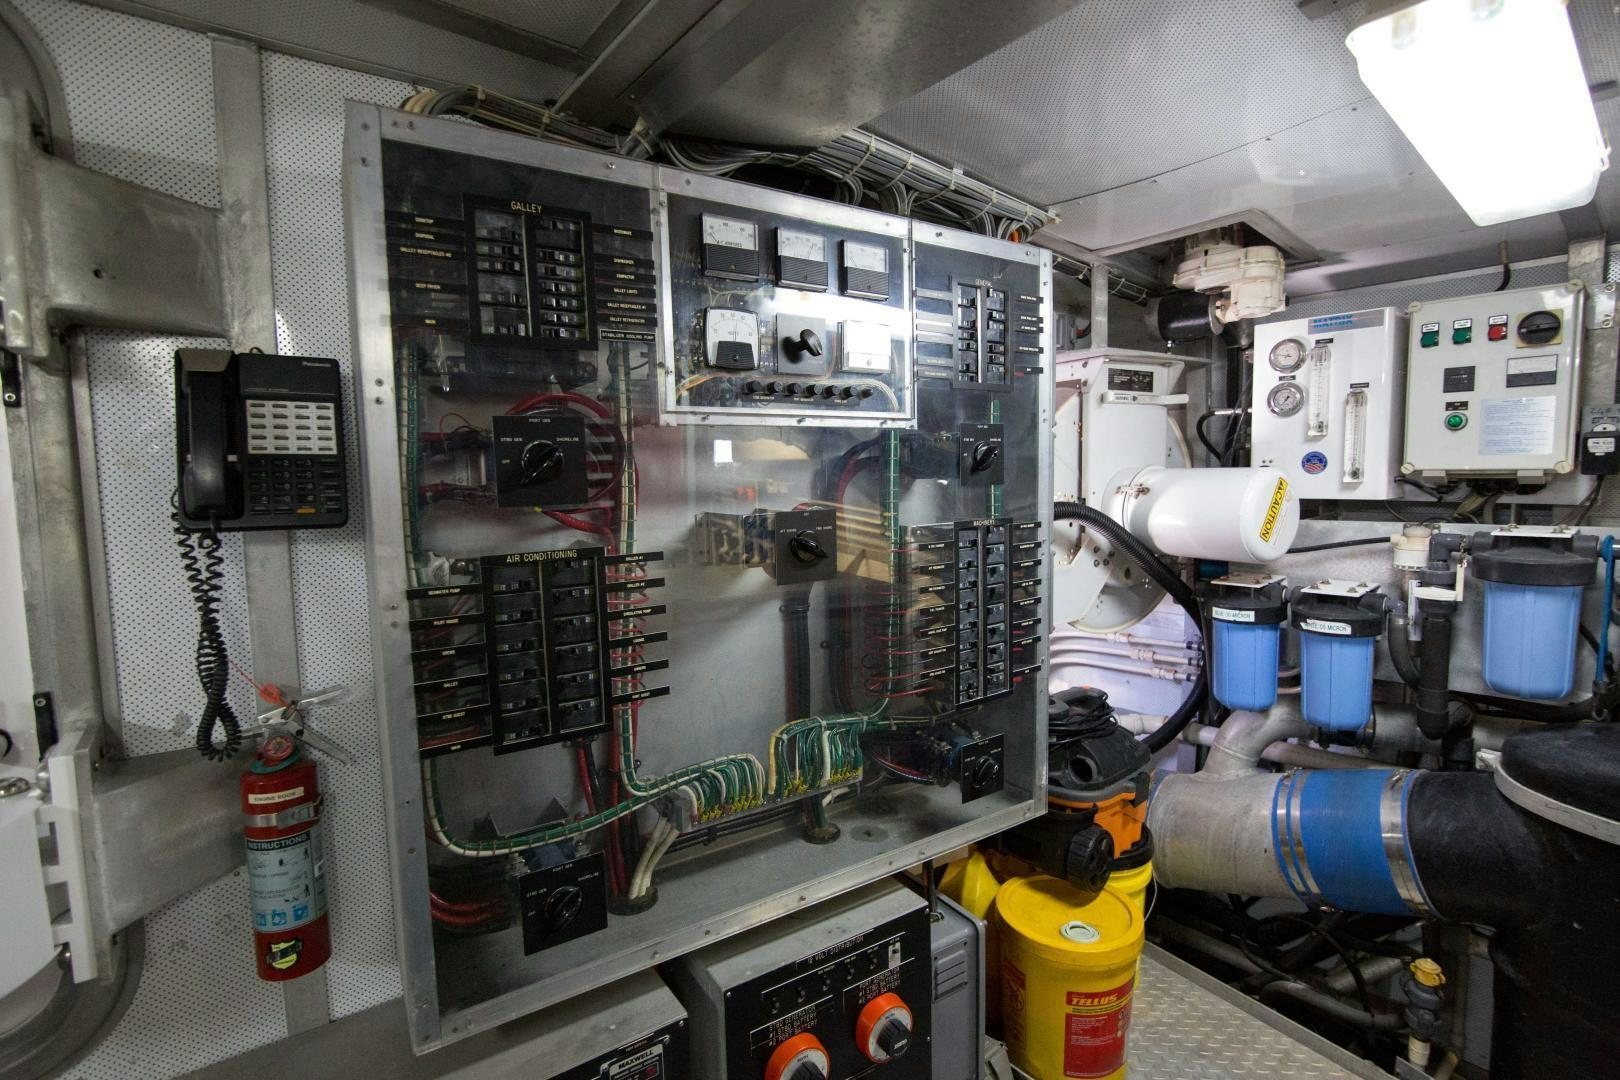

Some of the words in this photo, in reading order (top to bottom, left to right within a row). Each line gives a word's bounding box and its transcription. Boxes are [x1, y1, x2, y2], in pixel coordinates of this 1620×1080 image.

[511, 201, 542, 213] GALLEY
[1262, 490, 1283, 539] CAUTION
[506, 555, 520, 563] AIR
[523, 549, 578, 562] CONDITIONING
[1328, 625, 1347, 634] MICRON
[815, 950, 829, 961] VOLT
[830, 935, 864, 956] DISTRIBUTION
[1072, 993, 1118, 1007] TELLUS
[785, 1005, 816, 1023] GENERATOR
[778, 1023, 792, 1035] STBD
[794, 1012, 817, 1028] BATTERY
[794, 1019, 818, 1035] BATTERY
[618, 1049, 653, 1070] MAXWELL
